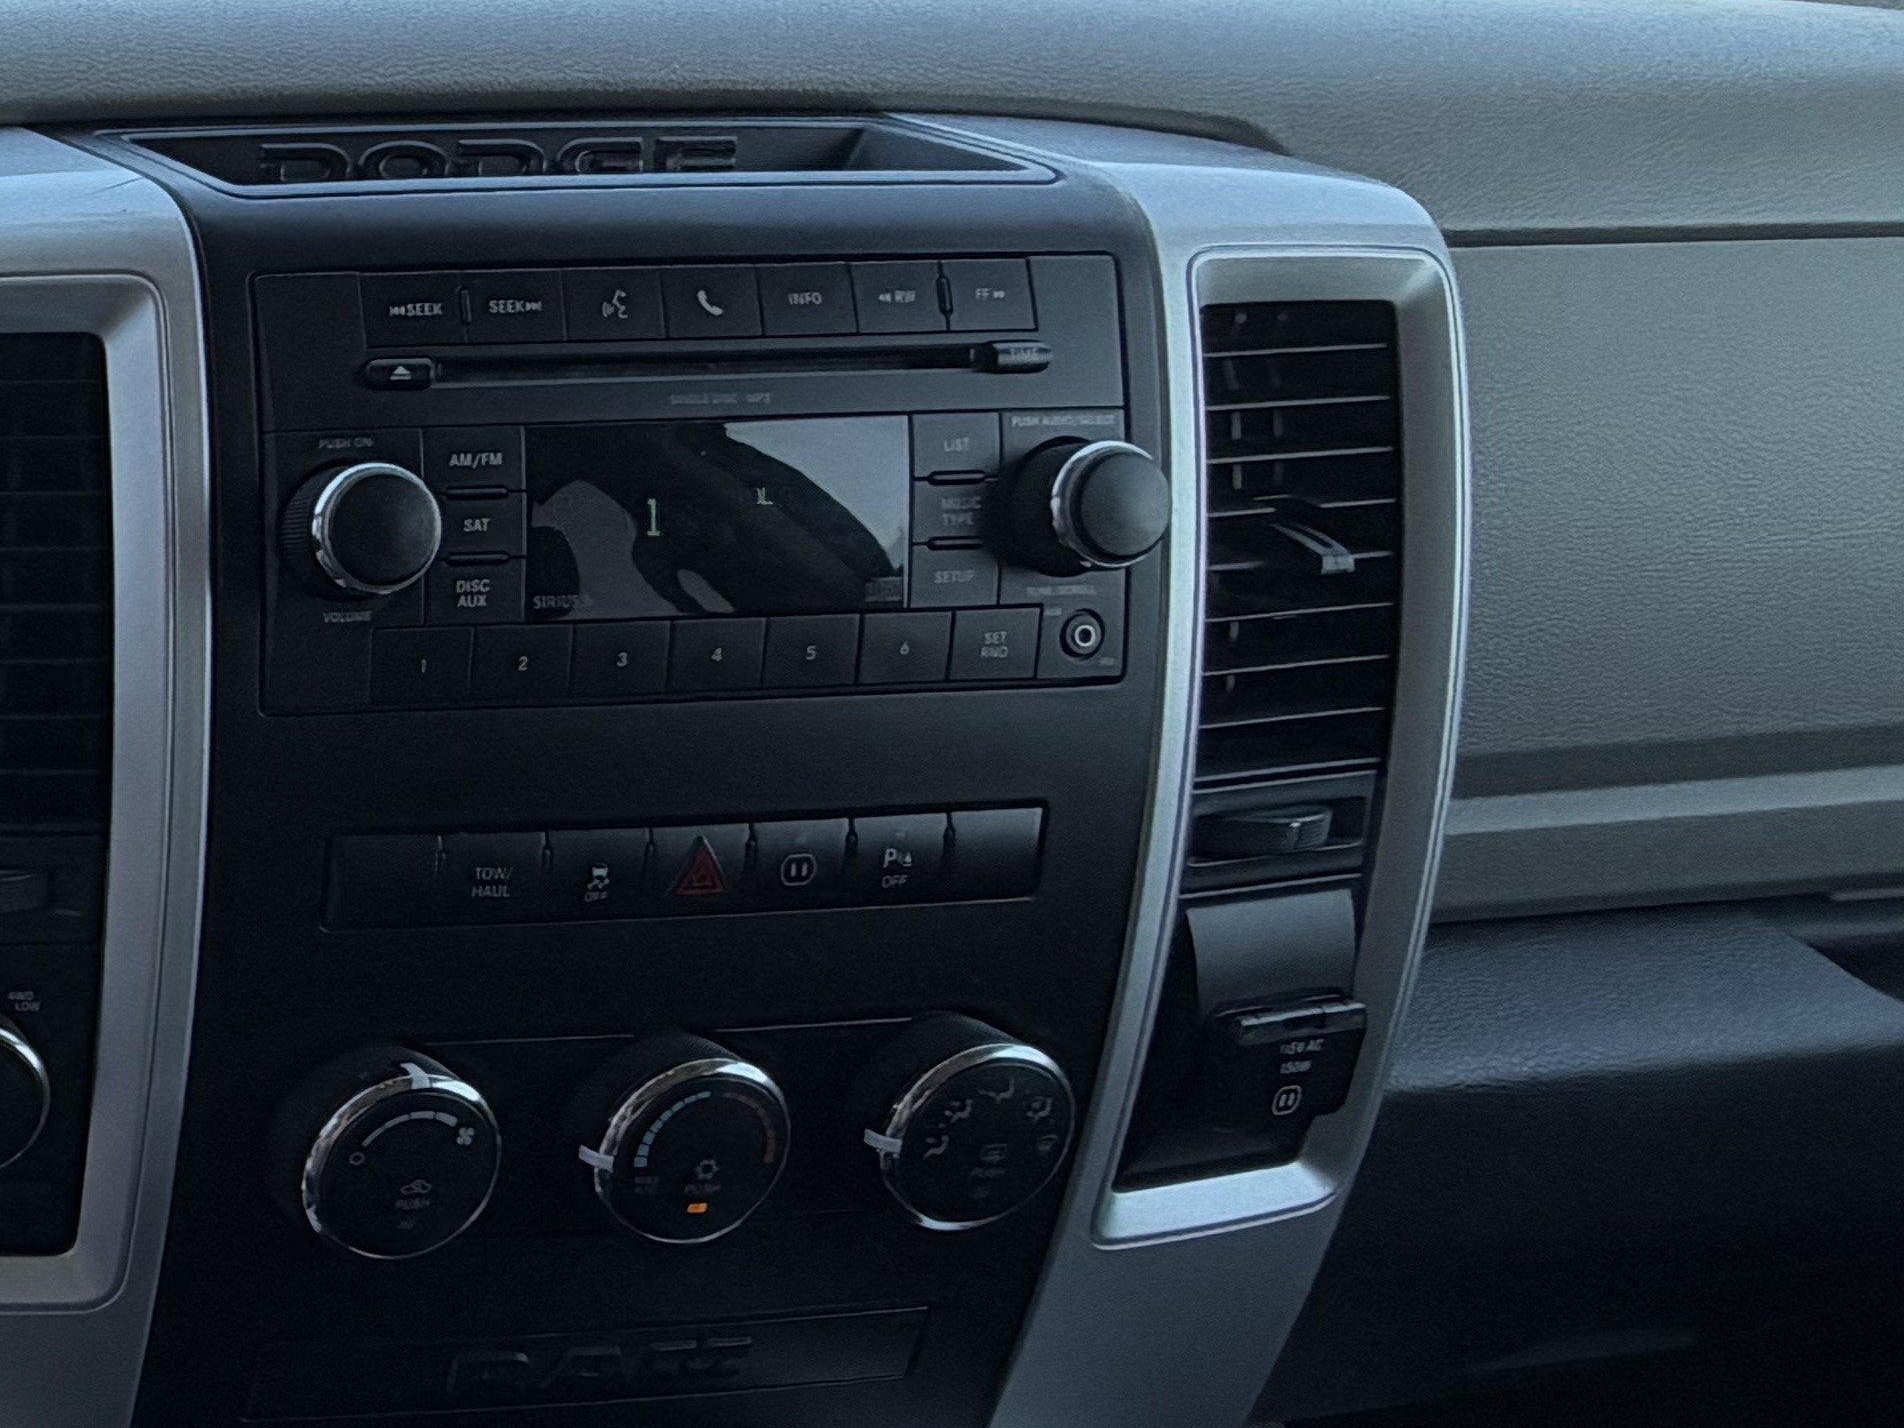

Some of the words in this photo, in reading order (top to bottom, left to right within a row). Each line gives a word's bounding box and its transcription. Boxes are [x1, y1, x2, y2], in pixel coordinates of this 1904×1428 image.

[788, 291, 823, 306] INFO
[975, 287, 991, 300] FF
[407, 302, 443, 317] SEEK
[488, 300, 526, 315] SEEK
[942, 435, 971, 453] LIST
[448, 452, 504, 469] AM/FM
[463, 517, 490, 533] SAT
[942, 512, 975, 526] TYPE
[934, 570, 975, 584] SETUP
[456, 579, 491, 594] DISC
[457, 593, 488, 609] AUX
[984, 631, 1008, 645] SET
[710, 647, 724, 663] 4
[805, 644, 818, 661] 5
[899, 640, 910, 656] 6
[420, 657, 428, 674] 1
[518, 655, 529, 672] 2
[616, 651, 629, 668] 3
[475, 866, 513, 881] TOW/
[882, 874, 907, 888] OFF
[471, 884, 510, 899] HAUL
[14, 1001, 41, 1012] LOW
